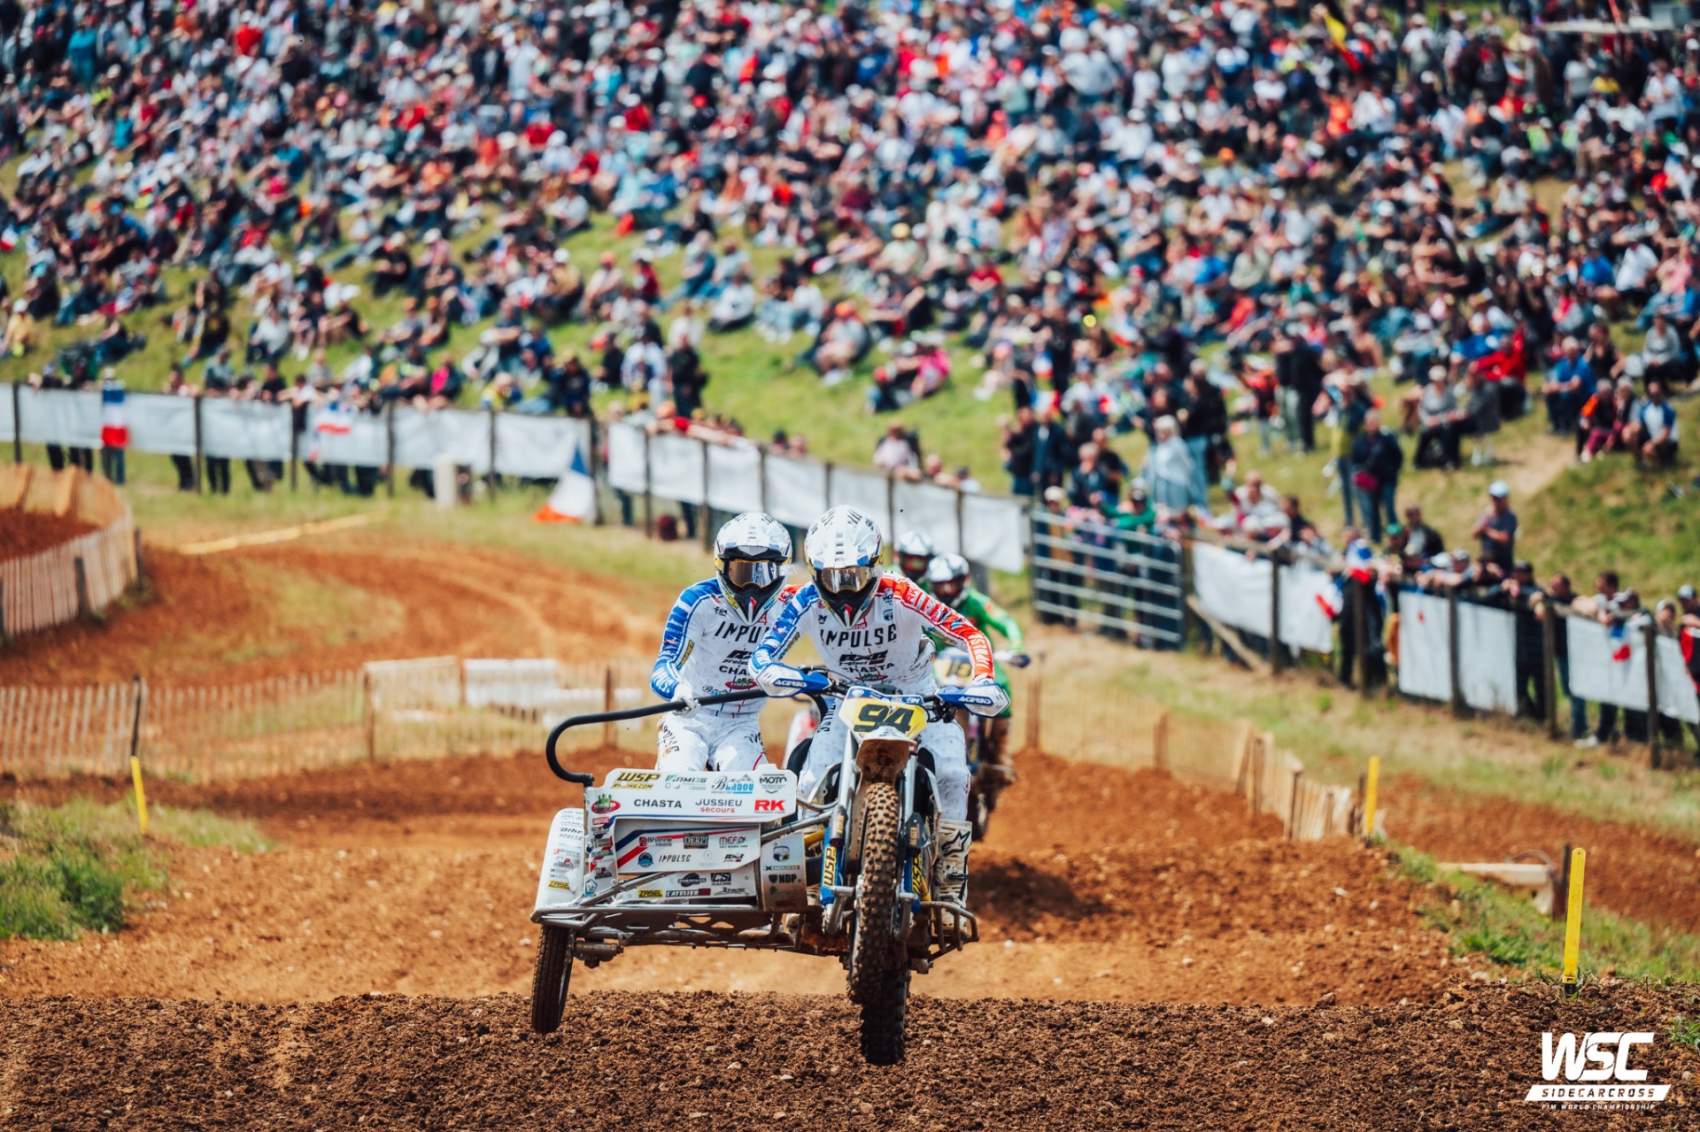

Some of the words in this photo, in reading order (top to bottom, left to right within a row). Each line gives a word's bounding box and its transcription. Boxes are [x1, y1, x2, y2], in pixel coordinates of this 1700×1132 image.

[714, 620, 769, 644] IMPU
[820, 623, 897, 648] IMPULSE
[719, 665, 750, 676] CHA
[853, 704, 914, 733] 94
[616, 772, 662, 782] WSP
[633, 798, 682, 808] CHASTA
[695, 799, 743, 807] JUSSIEU
[754, 799, 785, 812] RK
[824, 848, 836, 886] WSP
